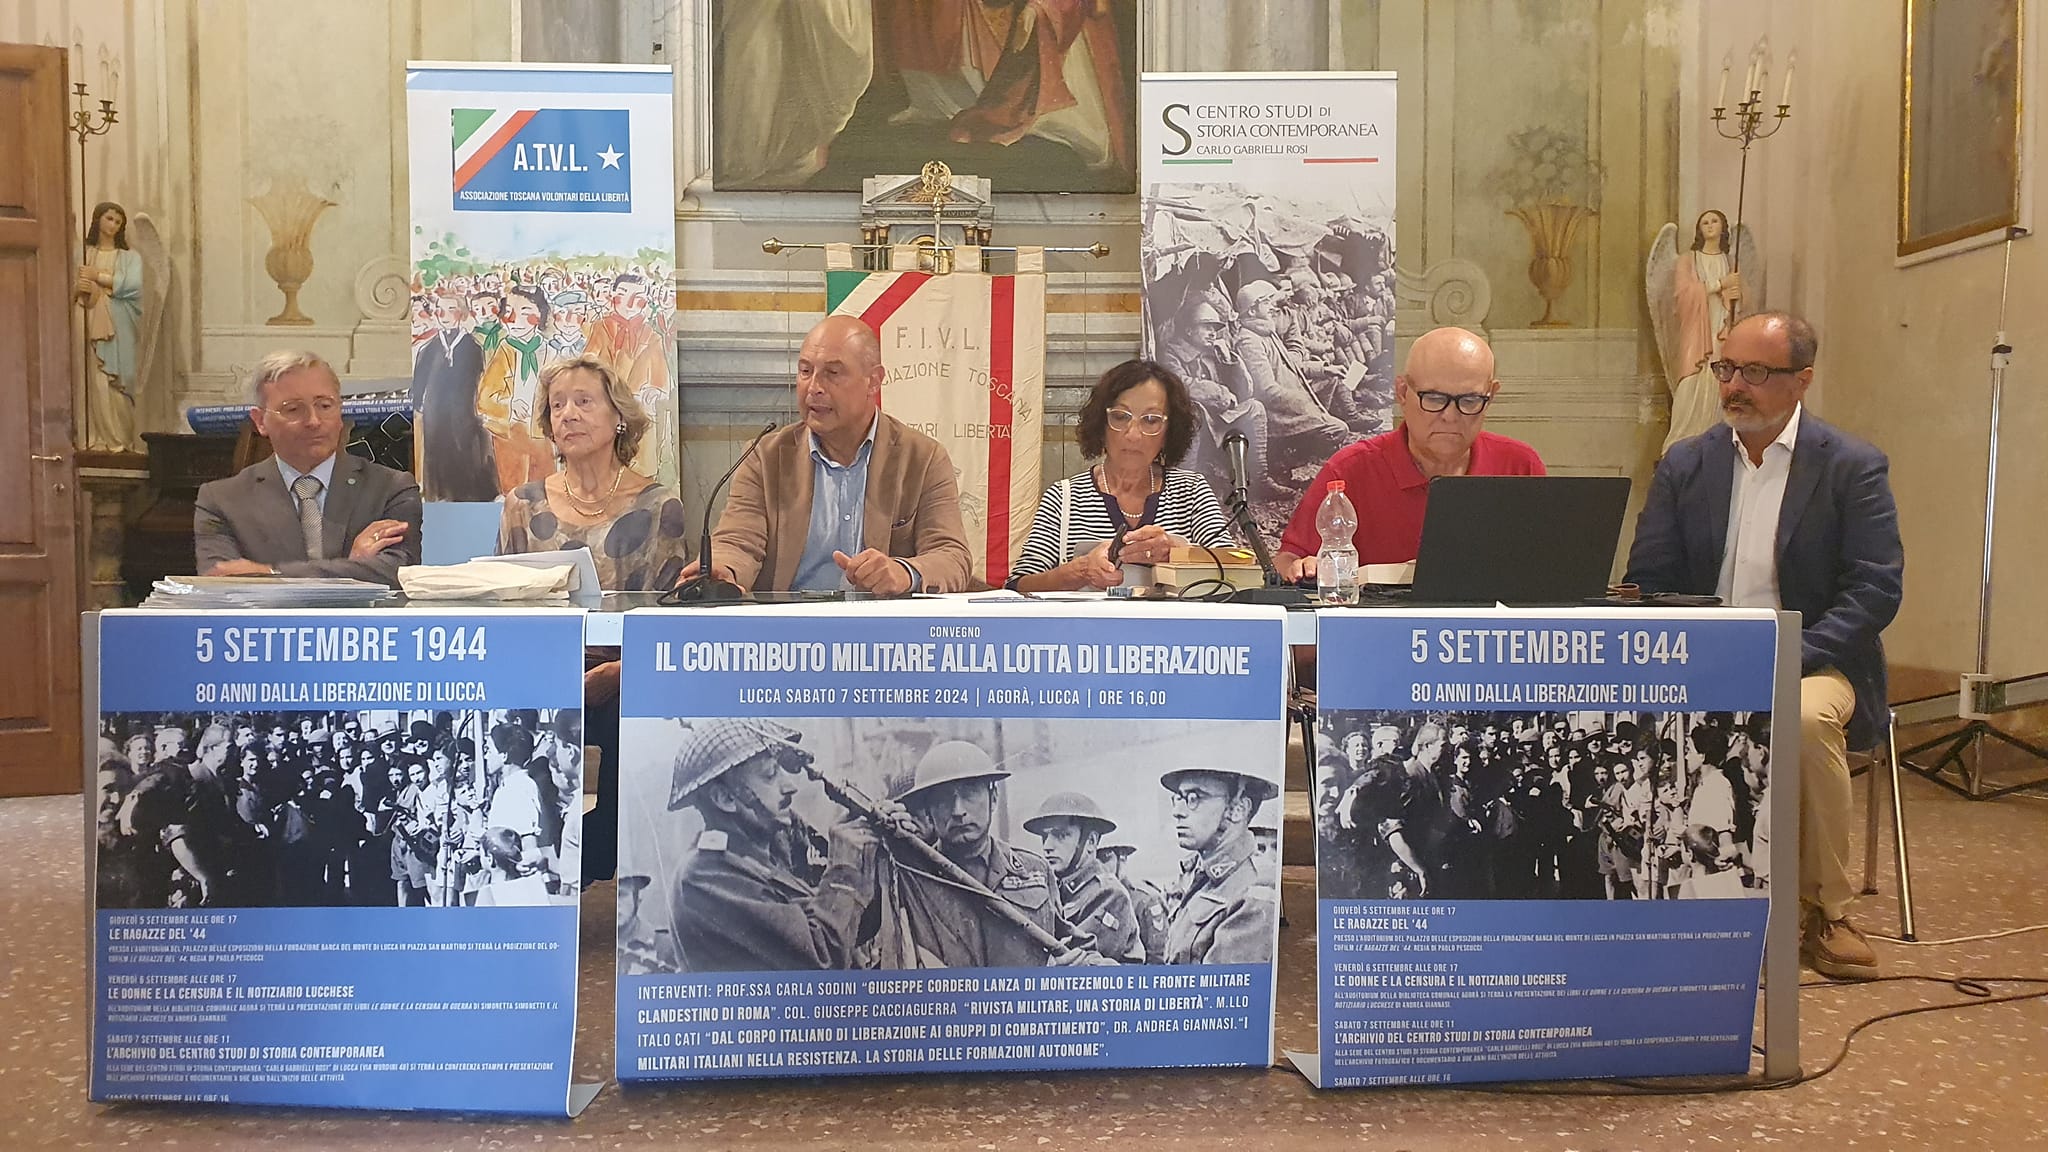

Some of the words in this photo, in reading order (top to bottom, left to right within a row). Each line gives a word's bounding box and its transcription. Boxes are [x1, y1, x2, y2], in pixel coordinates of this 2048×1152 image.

[1196, 105, 1260, 118] CENTRO
[1265, 105, 1311, 118] STUDI
[1319, 105, 1330, 116] DI
[1197, 124, 1246, 137] STORIA
[1250, 123, 1378, 137] CONTEMPORANEA
[1196, 145, 1231, 154] CARLO
[1233, 144, 1283, 154] GABRIELLI
[1286, 144, 1307, 154] ROSI
[460, 191, 508, 200] ASSOCIAZIONE
[510, 191, 540, 200] TOSCANA
[541, 192, 578, 201] VOLONTARI
[579, 192, 600, 201] DELLA
[601, 192, 629, 201] LIBERTÀ
[968, 367, 1032, 421] TOSCANA
[930, 626, 980, 637] CONVEGNO
[197, 628, 212, 661] 5
[224, 627, 398, 661] SETTEMBRE
[412, 627, 486, 660] 1944
[1412, 629, 1427, 662] 5
[1439, 630, 1604, 663] SETTEMBRE
[1618, 630, 1688, 664] 1944
[656, 642, 676, 670] IL
[683, 642, 825, 671] CONTRIBUTO
[832, 643, 935, 671] MILITARE
[941, 643, 996, 672] ALLA
[1004, 644, 1071, 672] LOTTA
[1078, 645, 1098, 672] DI
[1106, 645, 1249, 674] LIBERAZIONE
[196, 683, 215, 702] 80
[220, 683, 256, 702] ANNI
[261, 683, 308, 702] DALLA
[314, 682, 412, 701] LIBERAZIONE
[417, 682, 431, 700] DI
[436, 681, 485, 701] LUCCA
[740, 688, 780, 703] LUCCA
[786, 688, 834, 702] SABATO
[841, 688, 847, 702] 7
[853, 688, 929, 703] SETTEMBRE
[935, 689, 967, 703] 2024
[1039, 690, 1079, 704] LUCCA
[1099, 688, 1122, 704] ORE
[1129, 690, 1165, 706] 16,00
[1411, 683, 1430, 701] 80
[1435, 683, 1470, 701] ANNI
[1475, 684, 1521, 702] DALLA
[1526, 684, 1618, 702] LIBERAZIONE
[1622, 684, 1636, 702] DI
[1641, 684, 1687, 703] LUCCA
[1333, 905, 1360, 914] GIOVEDÌ
[1363, 906, 1367, 914] 5
[1369, 906, 1409, 914] SETTEMBRE
[1412, 906, 1428, 914] ALLE
[1431, 906, 1444, 915] ORE
[1447, 906, 1455, 915] 17
[1334, 918, 1344, 928] LE
[1348, 918, 1388, 929] RAGAZZE
[1392, 918, 1408, 929] DEL
[1412, 918, 1426, 929] '44
[1334, 962, 1363, 971] VENERDÌ
[1366, 963, 1370, 971] 6
[1372, 963, 1412, 971] SETTEMBRE
[1415, 963, 1431, 971] ALLE
[1433, 963, 1446, 971] ORE
[1450, 963, 1457, 971] 17
[108, 987, 118, 998] LE
[121, 987, 151, 999] DONNE
[155, 988, 160, 998] E
[164, 988, 175, 999] LA
[178, 987, 222, 999] CENSURA
[226, 987, 232, 998] E
[235, 987, 244, 998] IL
[247, 986, 302, 997] NOTIZIARIO
[306, 985, 353, 997] LUCCHESE
[638, 984, 711, 999] INTERVENTI:
[717, 983, 770, 996] PROF.SSA
[776, 982, 812, 996] CARLA
[818, 982, 856, 995] SODINI
[928, 978, 978, 992] CORDERO
[984, 978, 1019, 991] LANZA
[1024, 978, 1035, 990] DI
[1040, 976, 1122, 990] MONTEZEMOLO
[1128, 976, 1134, 988] E
[1138, 976, 1148, 988] IL
[1153, 975, 1195, 988] FRONTE
[1200, 973, 1250, 986] MILITARE
[638, 1007, 718, 1023] CLANDESTINO
[722, 1006, 733, 1020] DI
[814, 1004, 868, 1018] GIUSEPPE
[872, 1002, 956, 1016] CACCIAGUERRA
[1076, 999, 1098, 1012] UNA
[1102, 998, 1140, 1011] STORIA
[1144, 998, 1154, 1010] DI
[1216, 995, 1248, 1008] M.LLO
[1334, 1020, 1360, 1029] SABATO
[1363, 1020, 1367, 1029] 7
[1370, 1020, 1409, 1028] SETTEMBRE
[1412, 1020, 1428, 1028] ALLE
[1430, 1020, 1443, 1028] ORE
[1446, 1020, 1454, 1028] 11
[638, 1033, 670, 1047] ITALO
[675, 1032, 699, 1046] CATI
[738, 1029, 775, 1043] CORPO
[780, 1028, 832, 1042] ITALIANO
[836, 1027, 847, 1041] DI
[852, 1025, 926, 1040] LIBERAZIONE
[930, 1025, 940, 1038] AI
[945, 1023, 985, 1037] GRUPPI
[990, 1023, 1000, 1036] DI
[1136, 1019, 1178, 1032] ANDREA
[107, 1047, 156, 1058] L'ARCHIVIO
[159, 1047, 176, 1058] DEL
[179, 1047, 215, 1058] CENTRO
[218, 1047, 246, 1058] STUDI
[250, 1047, 259, 1058] DI
[262, 1047, 296, 1058] STORIA
[300, 1046, 384, 1057] CONTEMPORANEA
[638, 1056, 689, 1070] MILITARI
[694, 1054, 742, 1068] ITALIANI
[747, 1052, 783, 1066] NELLA
[866, 1050, 879, 1062] LA
[883, 1048, 924, 1062] STORIA
[928, 1047, 962, 1060] DELLE
[966, 1045, 1034, 1059] FORMAZIONI
